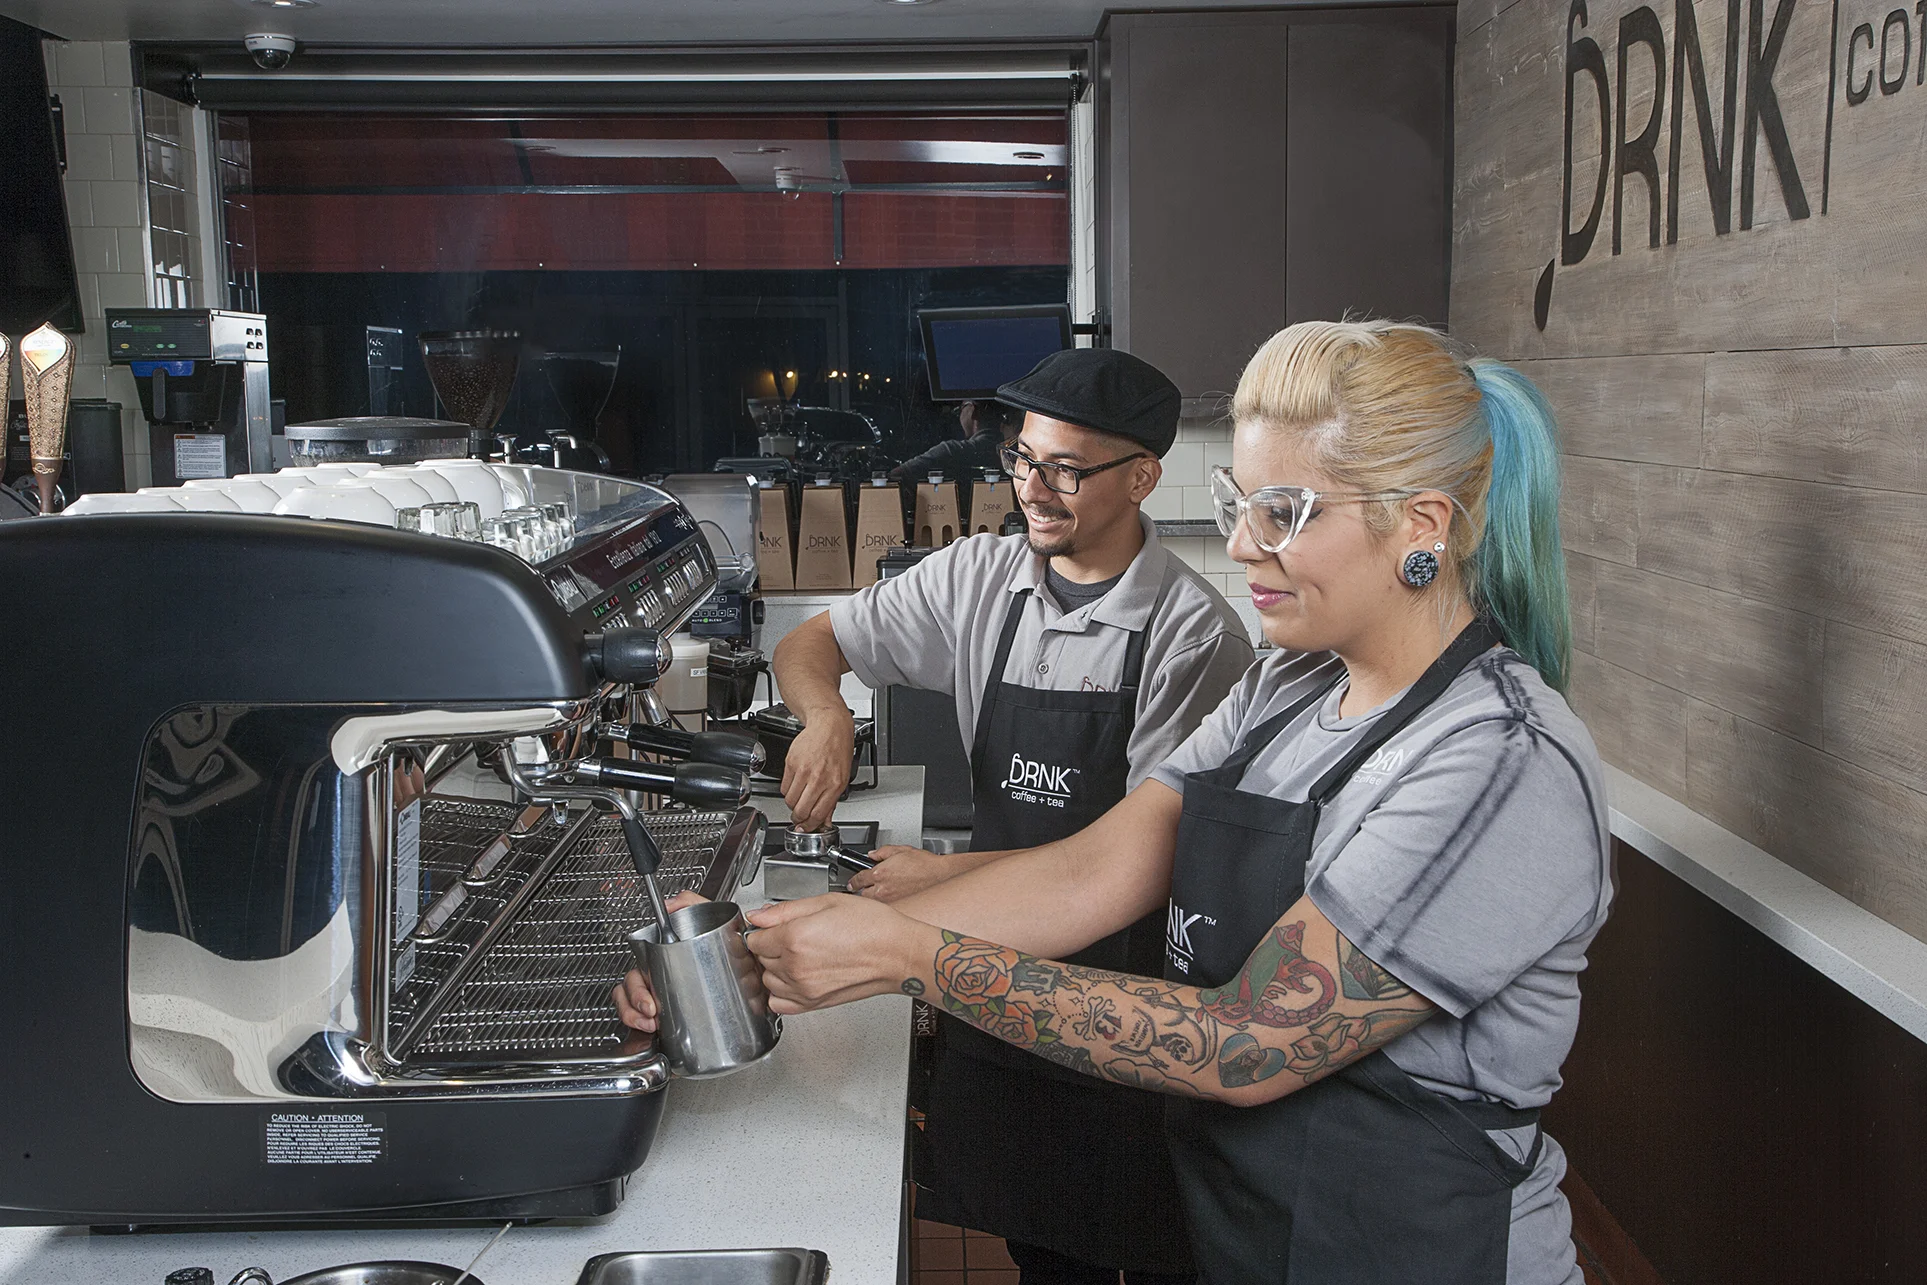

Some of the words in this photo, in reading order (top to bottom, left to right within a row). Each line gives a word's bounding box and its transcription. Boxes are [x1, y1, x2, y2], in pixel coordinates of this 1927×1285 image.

[1560, 0, 1811, 265] DRNK
[809, 533, 841, 548] DRNK
[865, 533, 898, 547] DRNK
[1008, 752, 1072, 794] DRNK
[1011, 790, 1037, 804] coffee
[1047, 796, 1064, 808] tea
[1172, 952, 1189, 975] tea
[271, 1114, 309, 1122] CAUTION
[317, 1114, 364, 1122] ATTENTION
